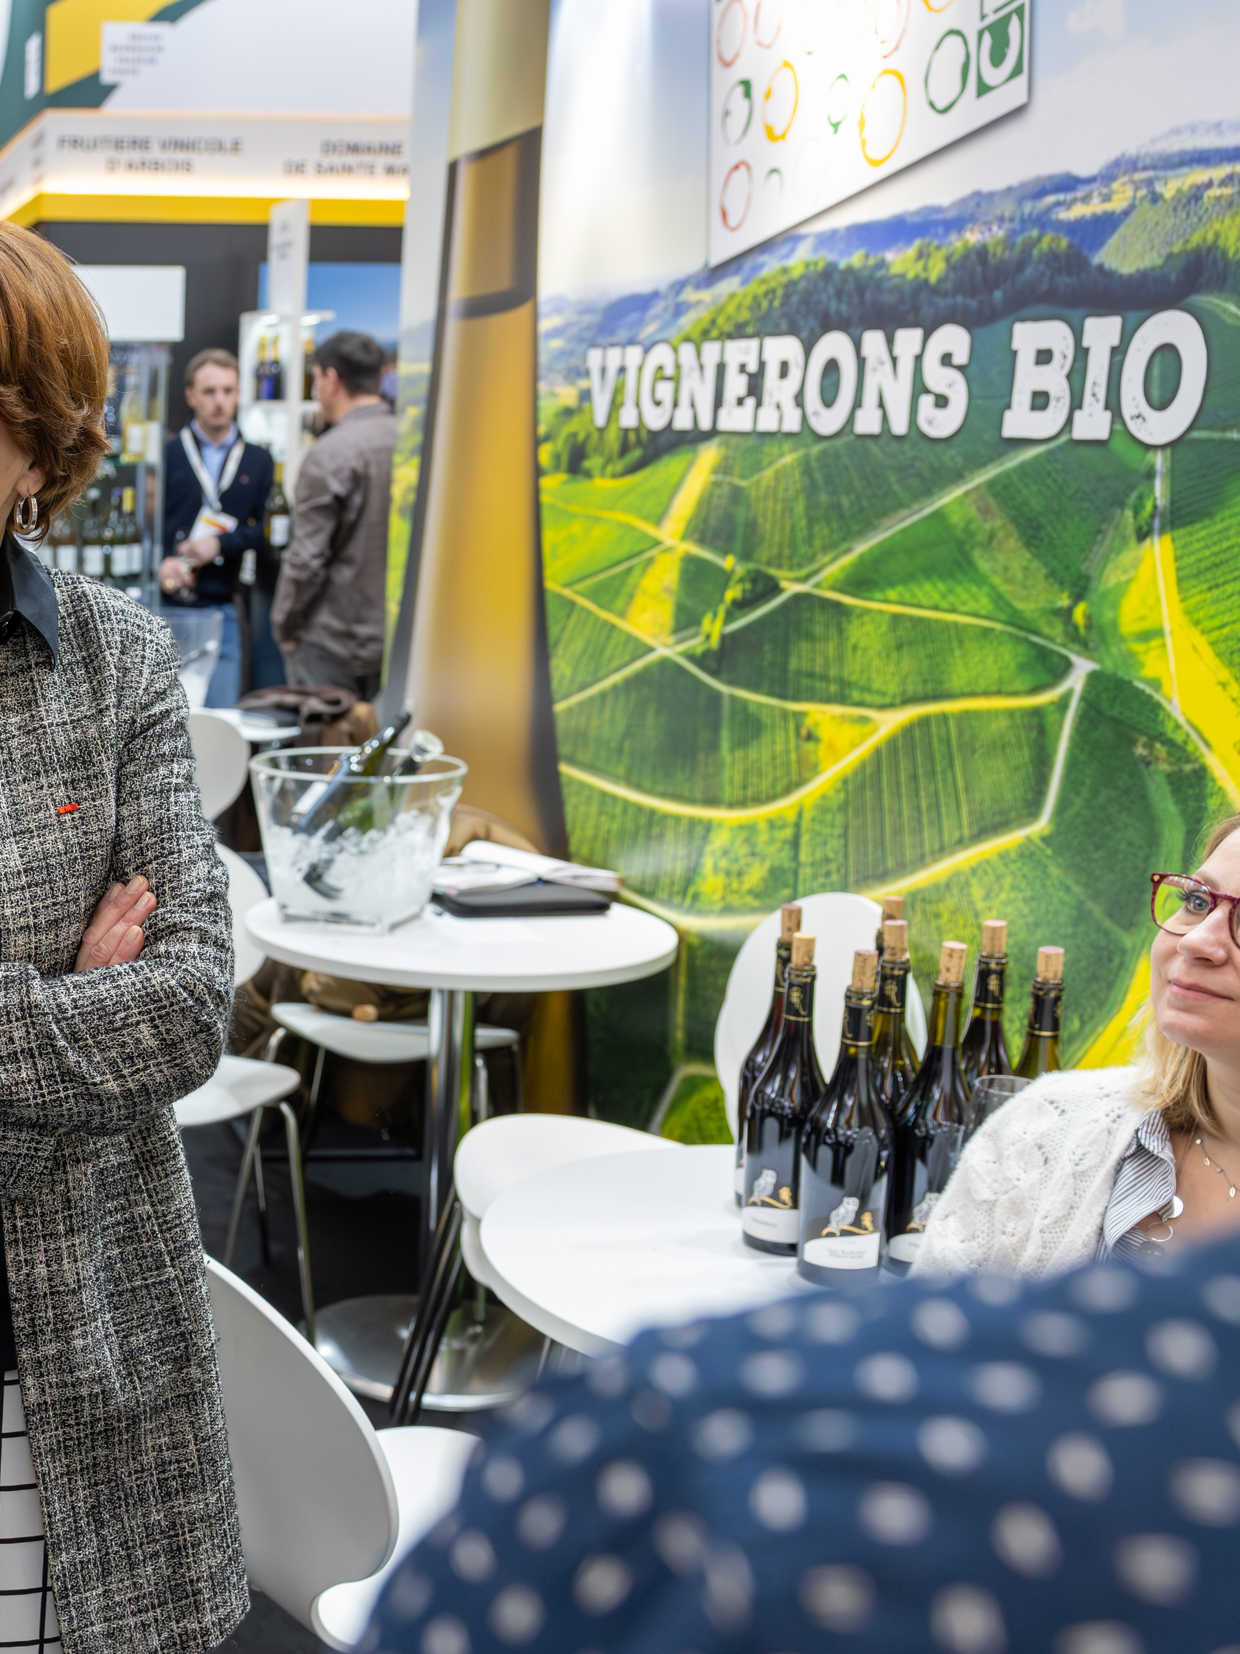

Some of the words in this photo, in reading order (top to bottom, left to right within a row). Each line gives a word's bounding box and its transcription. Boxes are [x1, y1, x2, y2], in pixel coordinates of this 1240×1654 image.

[320, 138, 405, 158] DOMAINE
[283, 159, 307, 177] DE
[314, 159, 376, 178] SAINTE
[586, 323, 971, 439] VIGNERONS
[1001, 309, 1208, 446] BIO
